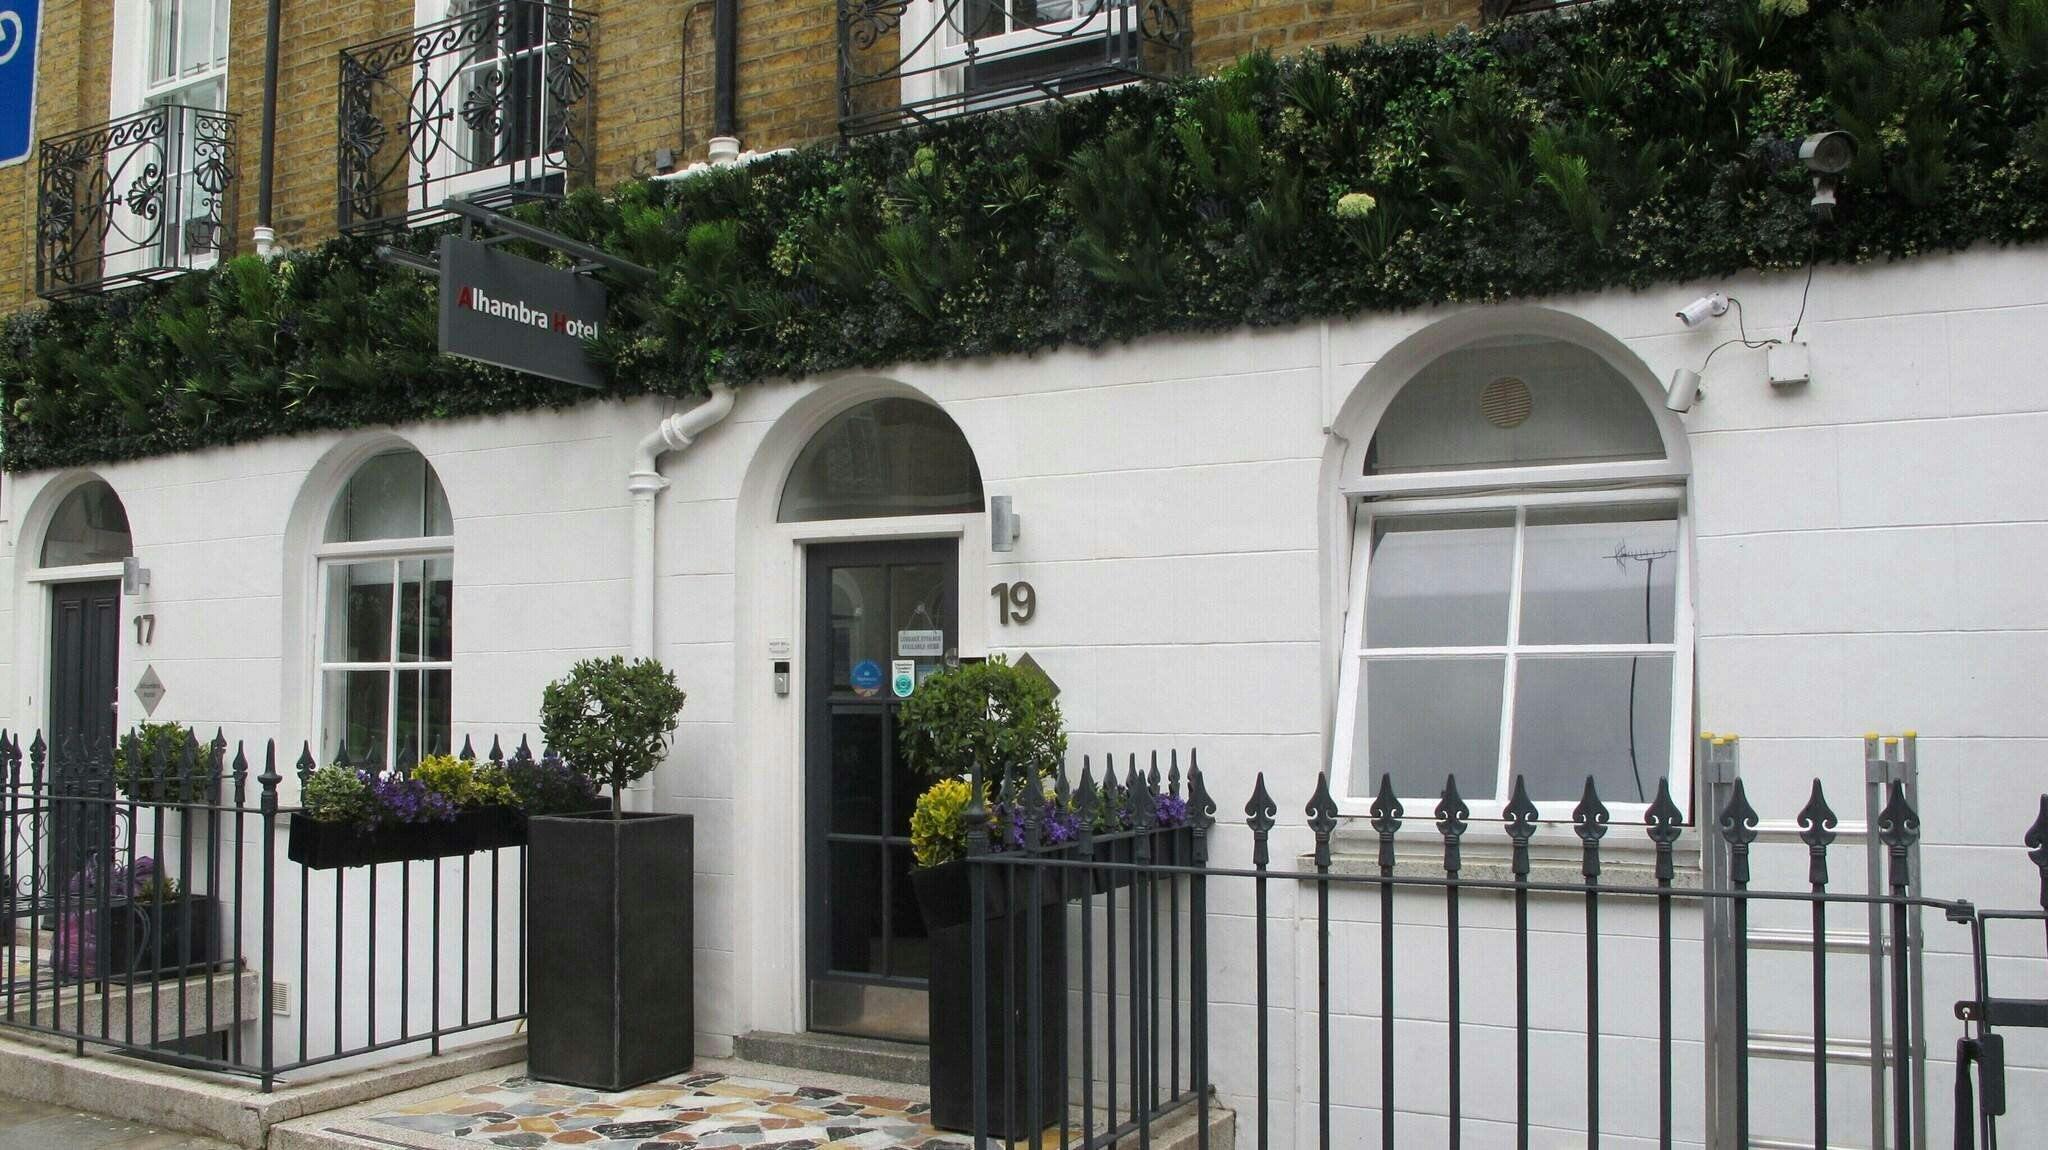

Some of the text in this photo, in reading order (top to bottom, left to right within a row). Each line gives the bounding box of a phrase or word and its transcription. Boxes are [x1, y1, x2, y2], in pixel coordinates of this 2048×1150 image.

[457, 285, 599, 340] Alhambra Hotel
[991, 581, 1036, 626] 19
[133, 614, 156, 646] 17
